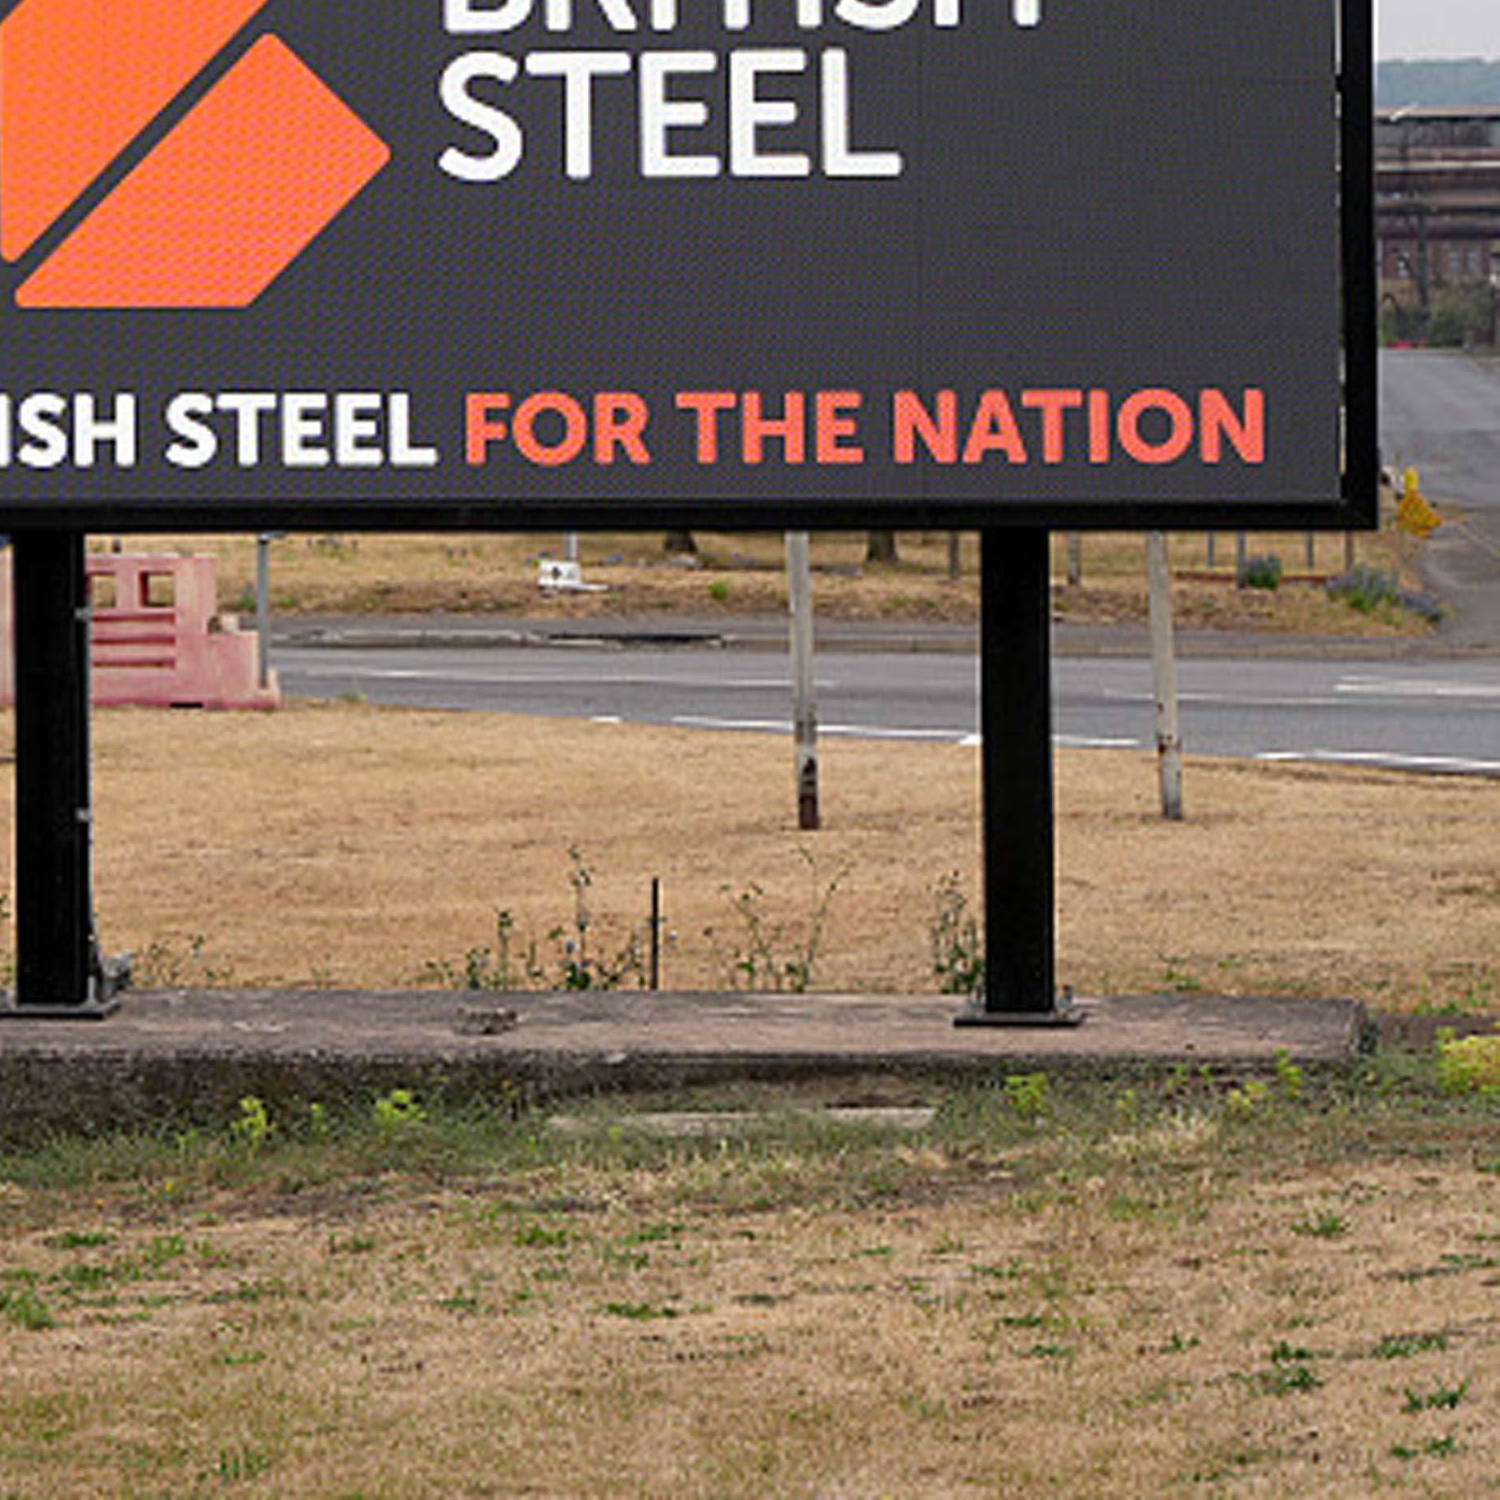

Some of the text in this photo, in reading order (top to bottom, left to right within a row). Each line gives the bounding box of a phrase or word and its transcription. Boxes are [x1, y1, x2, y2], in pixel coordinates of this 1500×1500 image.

[439, 49, 902, 182] STEEL
[165, 392, 438, 468] STEEL
[465, 391, 651, 466] FOR
[675, 390, 864, 465] THE
[893, 388, 1265, 464] NATION
